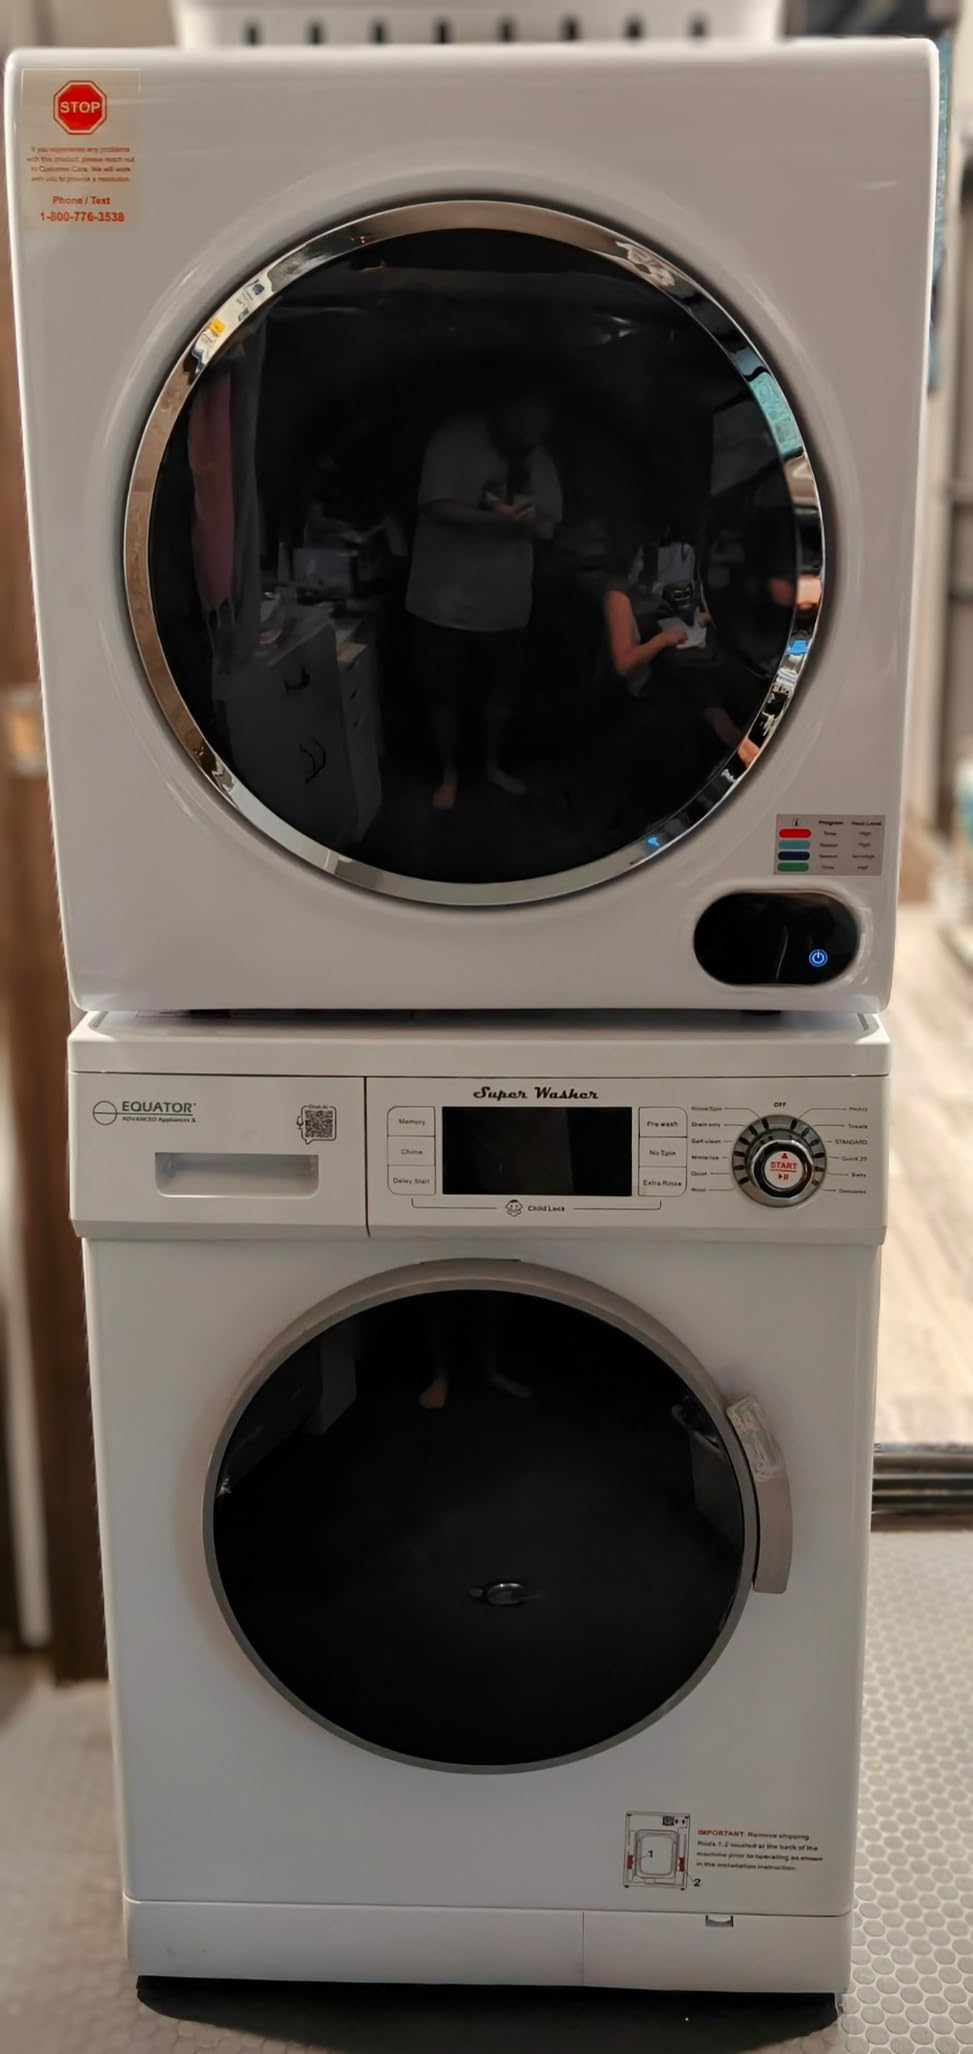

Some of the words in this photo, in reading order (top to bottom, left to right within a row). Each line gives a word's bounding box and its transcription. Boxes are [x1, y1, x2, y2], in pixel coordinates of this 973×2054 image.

[59, 101, 100, 114] STOP
[53, 195, 83, 204] Phone
[90, 195, 111, 204] Text
[40, 211, 125, 222] 1-800-776-3538
[473, 1086, 528, 1102] Super
[534, 1086, 599, 1100] Washer
[399, 1117, 426, 1126] Memory
[770, 1162, 799, 1170] START
[393, 1177, 412, 1185] Delay
[693, 1878, 702, 1887] 2
